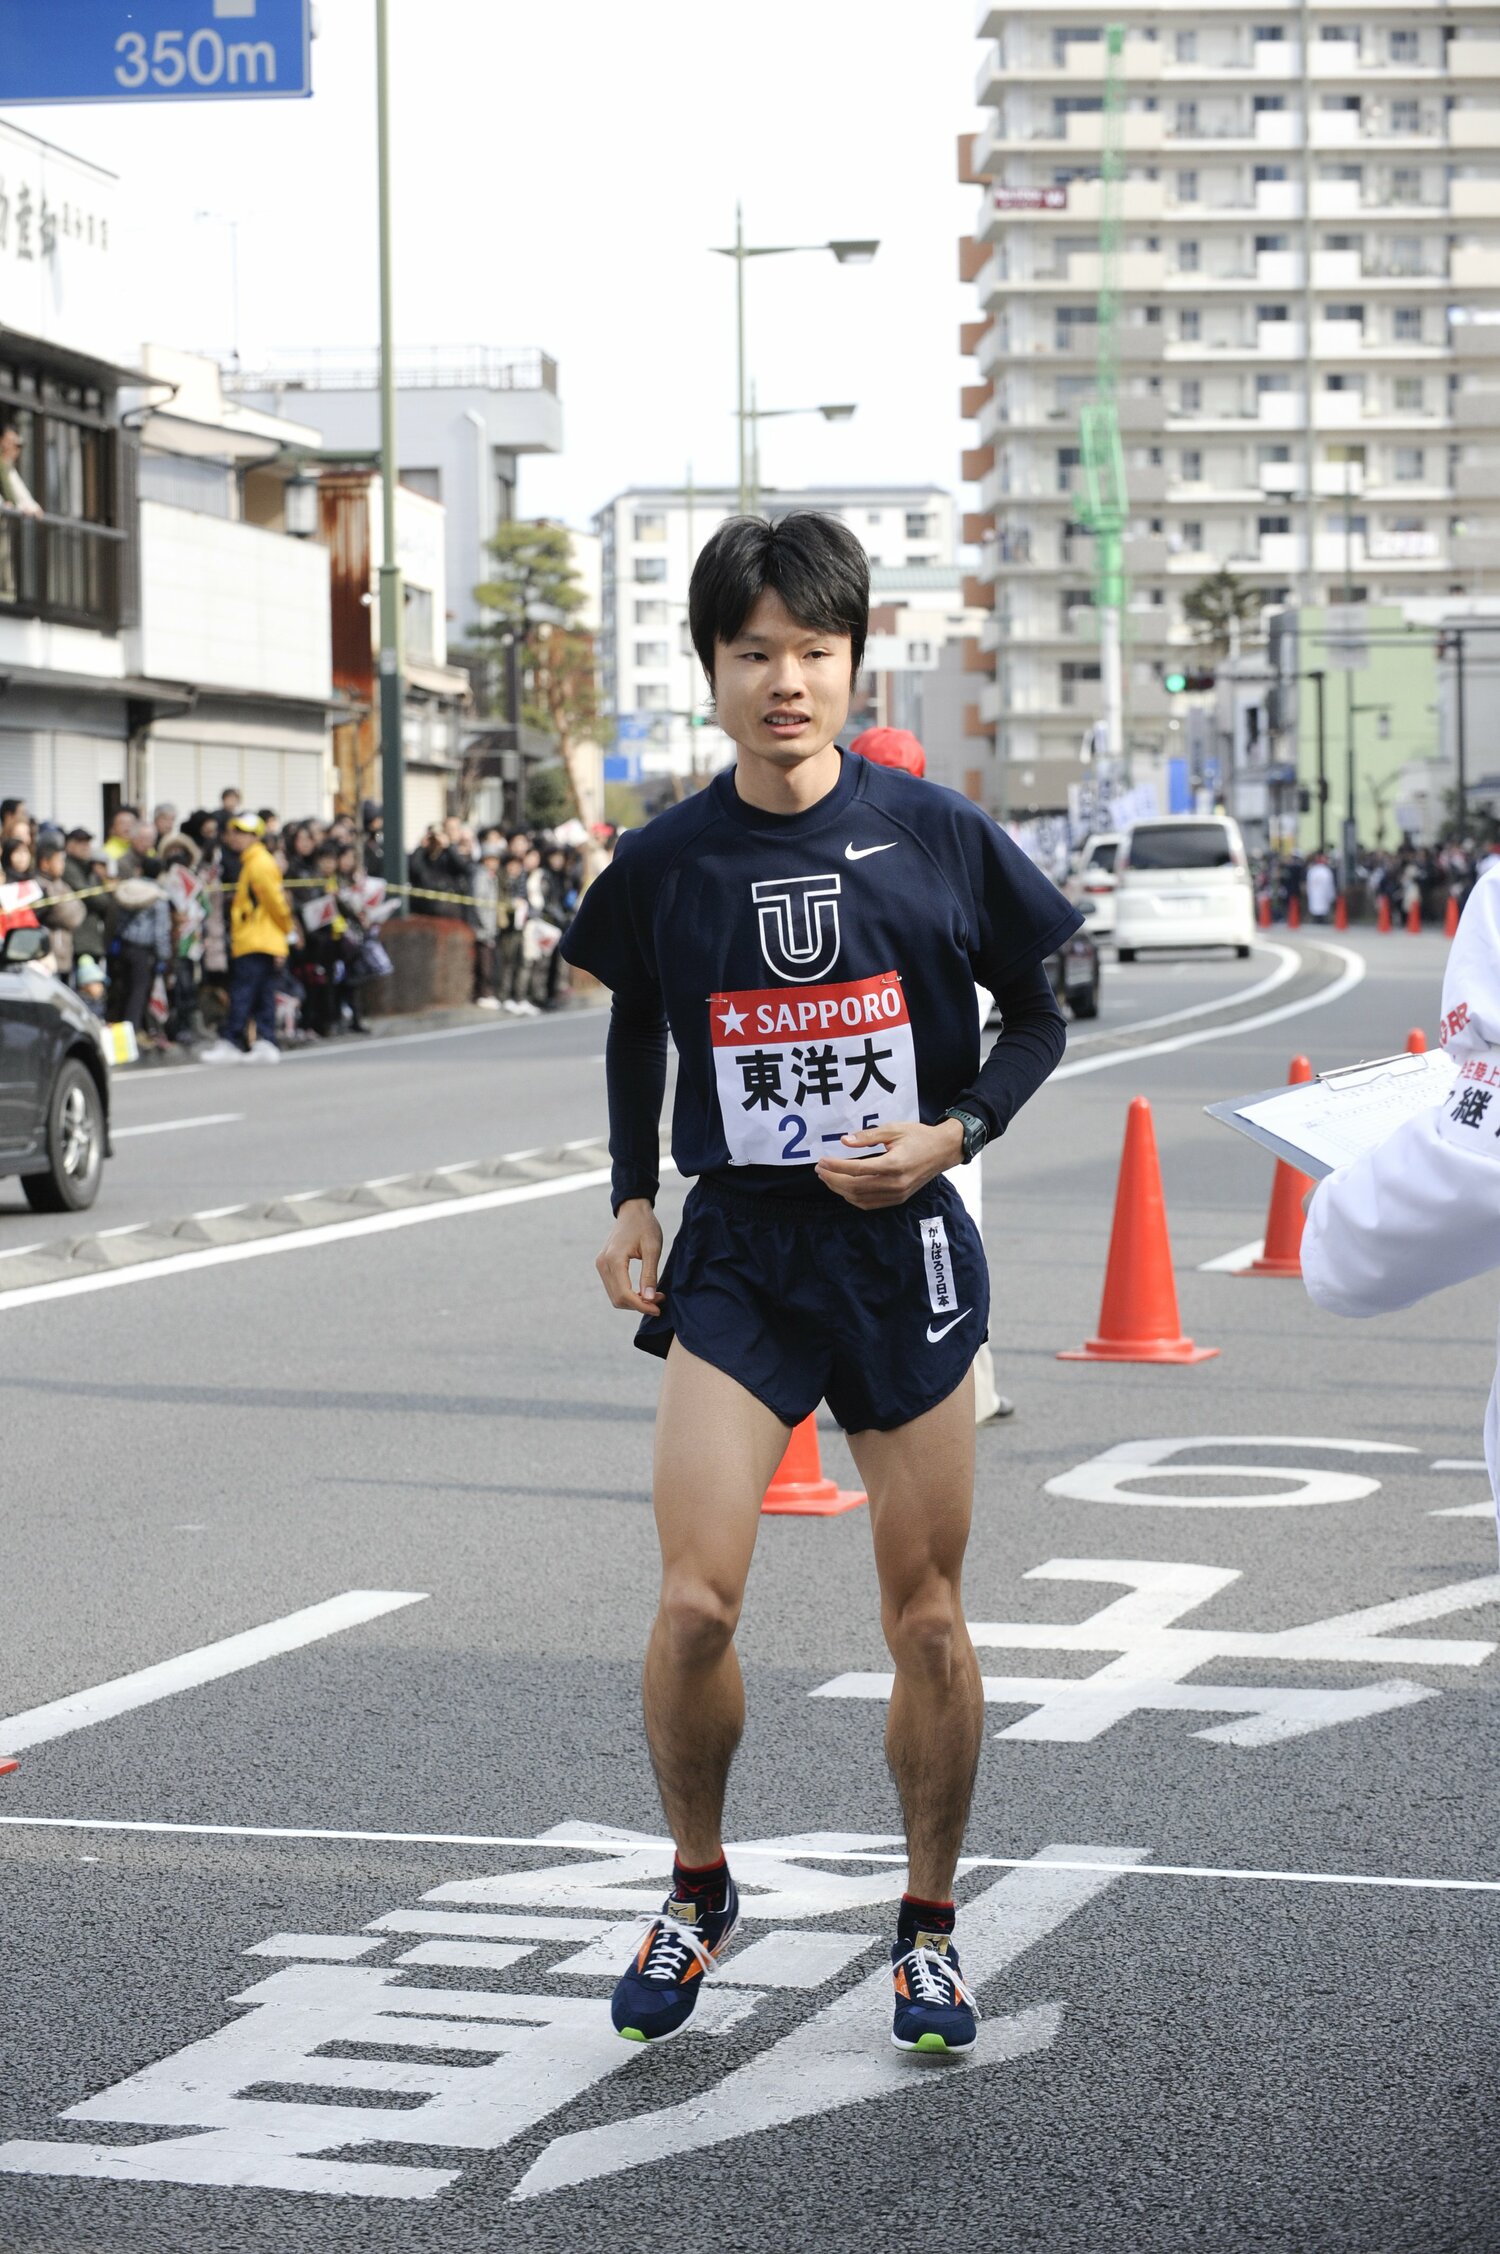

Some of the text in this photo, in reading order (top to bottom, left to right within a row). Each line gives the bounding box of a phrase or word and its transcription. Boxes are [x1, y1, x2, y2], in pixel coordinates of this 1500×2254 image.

[114, 28, 277, 88] 350m
[756, 987, 901, 1035] SAPPORO
[735, 1037, 897, 1112] 東洋大
[928, 1226, 950, 1307] がんばろう日本
